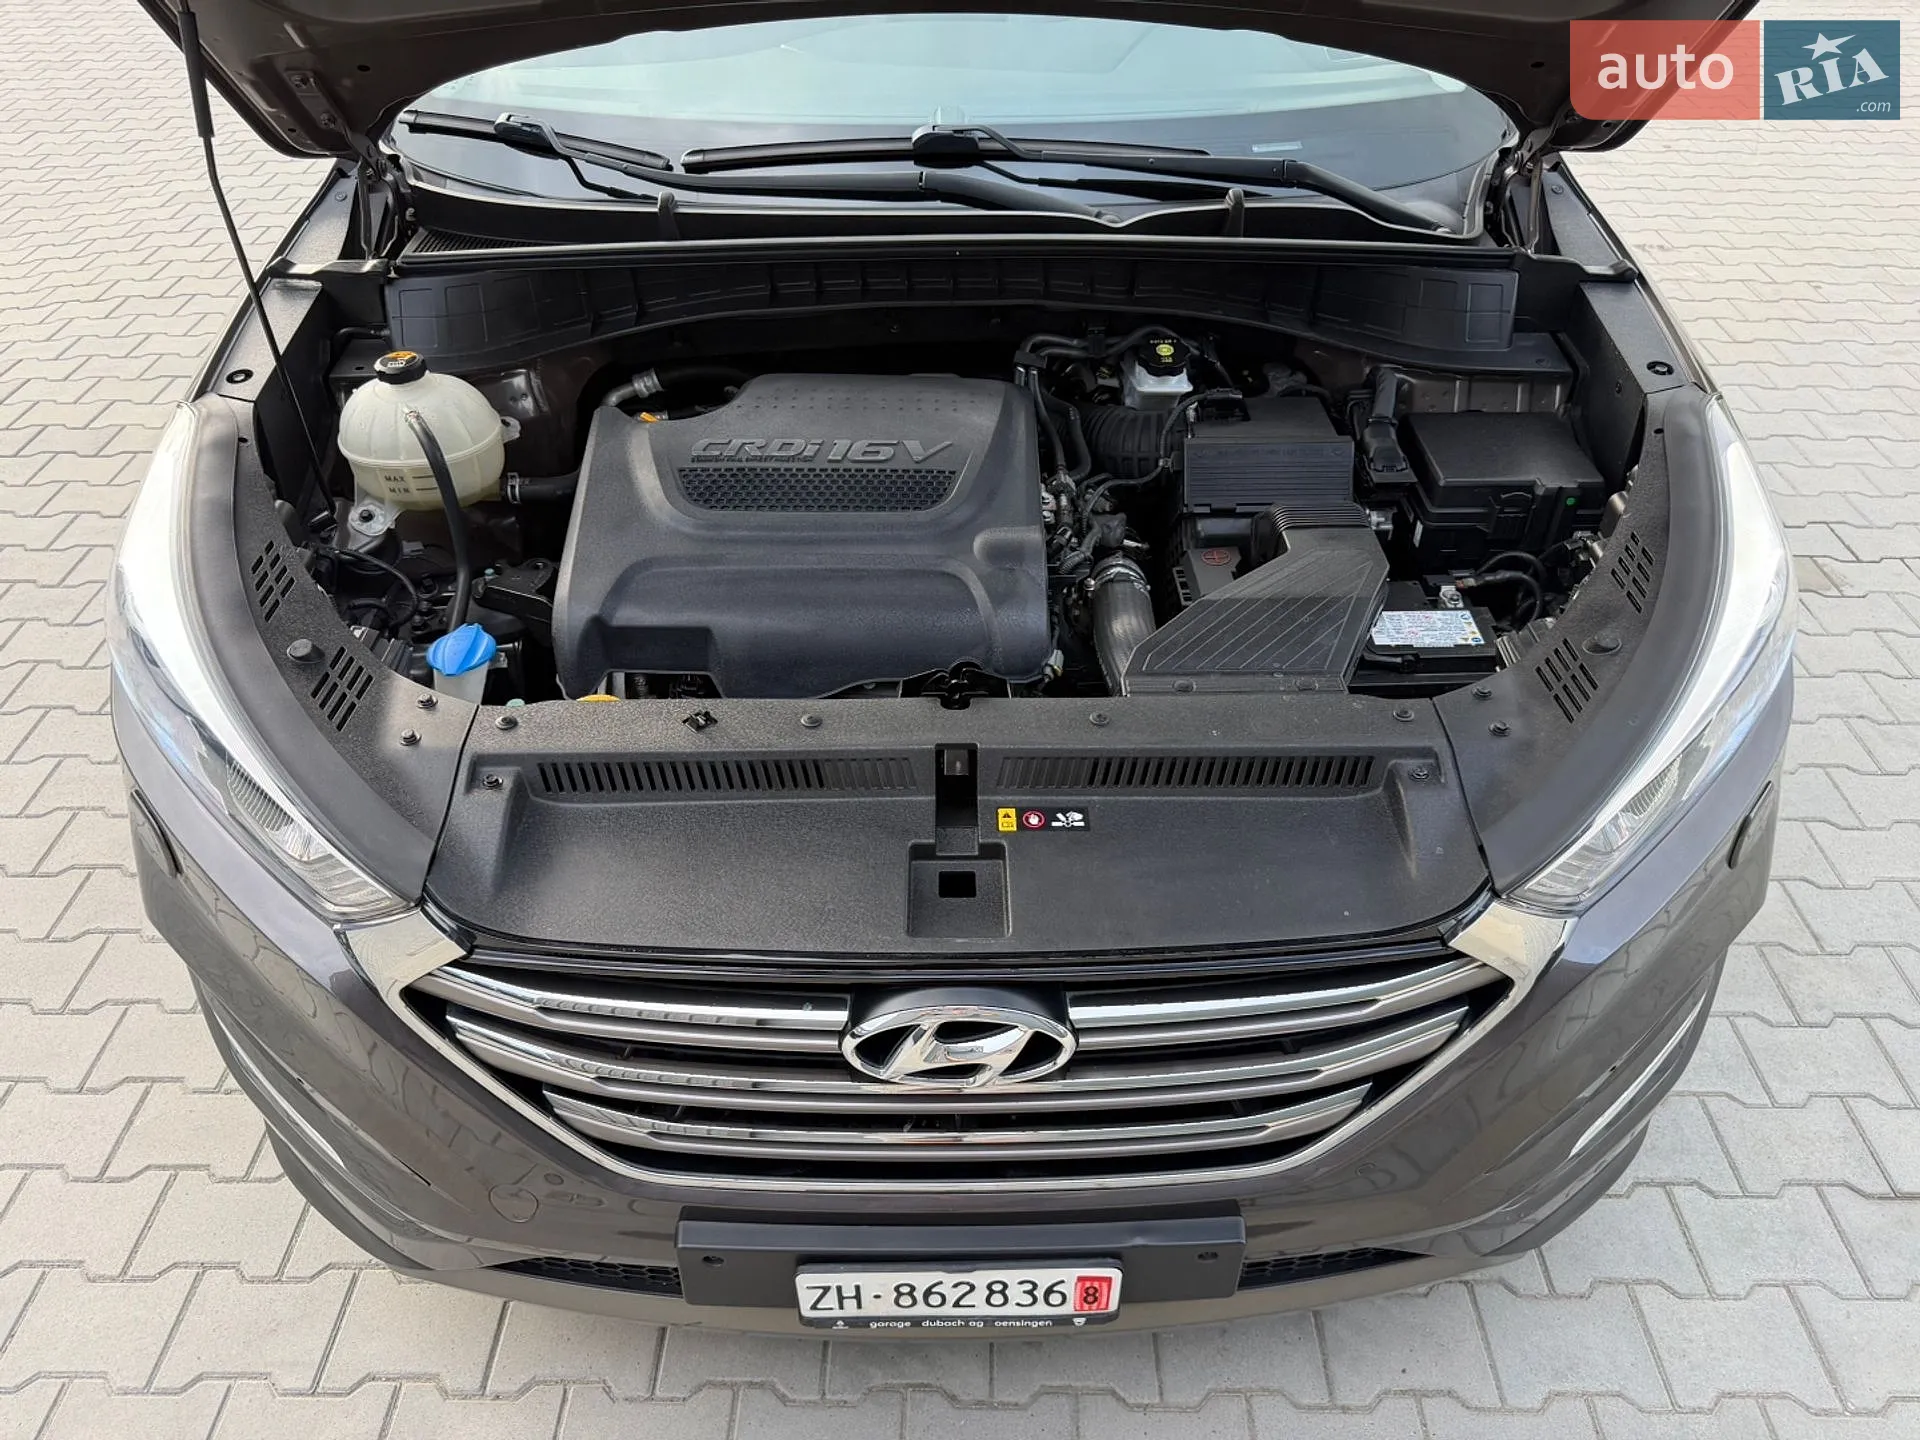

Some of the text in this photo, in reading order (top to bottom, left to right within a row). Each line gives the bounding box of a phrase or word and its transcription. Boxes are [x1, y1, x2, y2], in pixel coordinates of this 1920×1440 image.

[869, 1320, 911, 1329] garage
[921, 1319, 965, 1328] dubach
[994, 1319, 1053, 1328] oensingen
